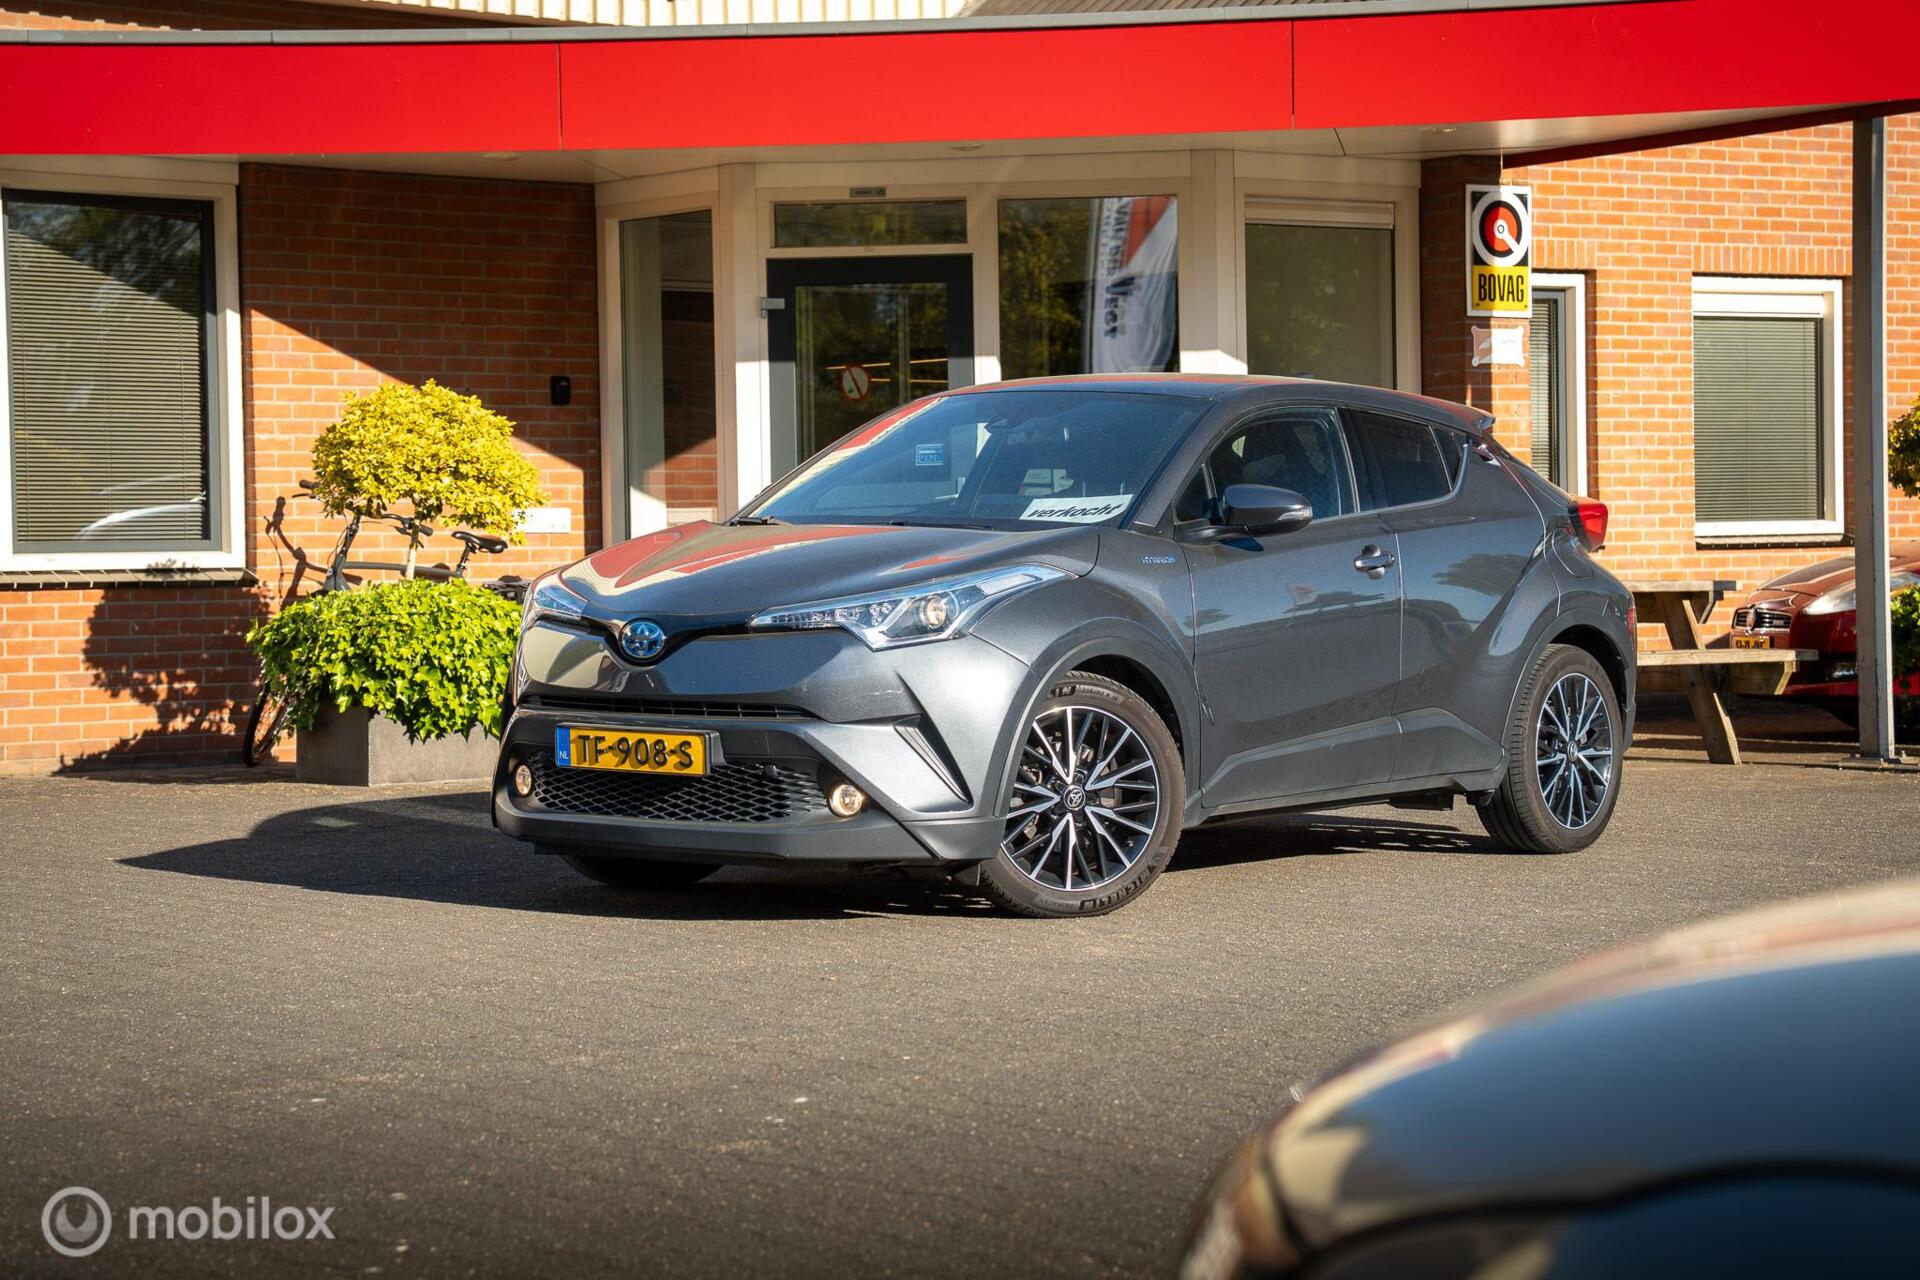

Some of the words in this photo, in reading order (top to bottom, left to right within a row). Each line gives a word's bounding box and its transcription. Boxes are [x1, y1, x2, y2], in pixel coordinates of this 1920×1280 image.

[1478, 273, 1524, 302] BOVAG
[1027, 503, 1124, 518] verkocht
[559, 751, 569, 760] NL
[577, 734, 694, 768] TF-908-S
